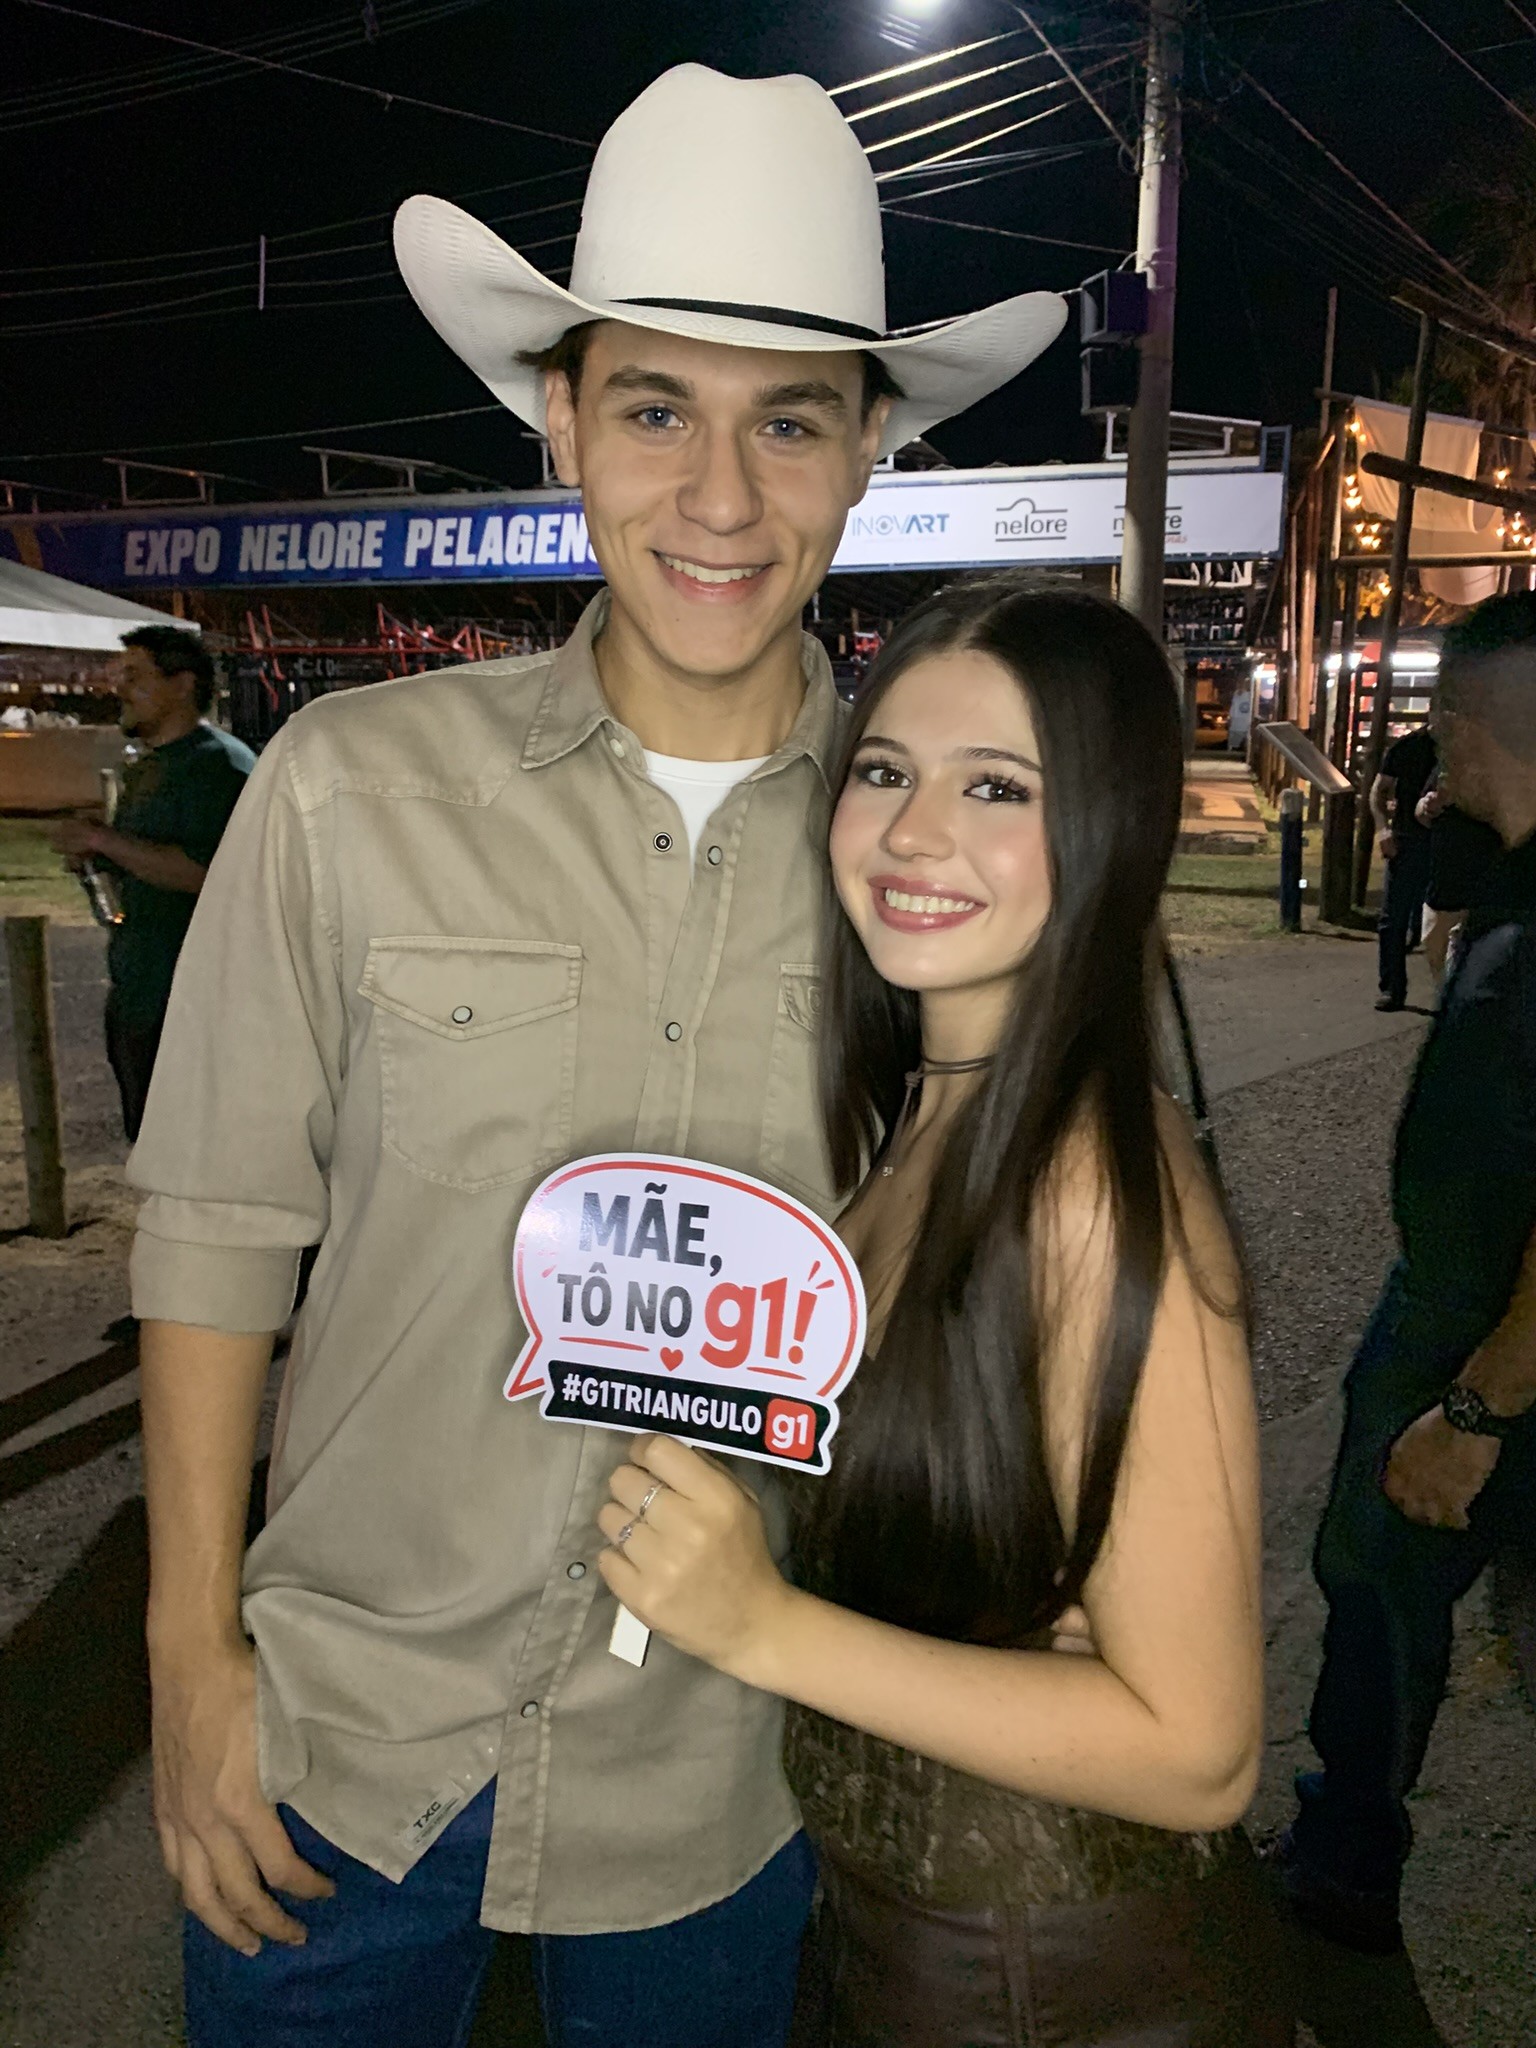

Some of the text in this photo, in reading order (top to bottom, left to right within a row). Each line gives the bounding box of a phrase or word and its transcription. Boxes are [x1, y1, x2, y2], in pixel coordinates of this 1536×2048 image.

[124, 512, 598, 577] EXPO NELORE PELAGEN
[852, 513, 950, 536] INOVART
[995, 514, 1068, 535] nelore
[579, 1181, 723, 1277] MÃE,
[557, 1261, 818, 1369] TÔ NO g1!
[561, 1372, 809, 1449] #G1TRIANGULO g1
